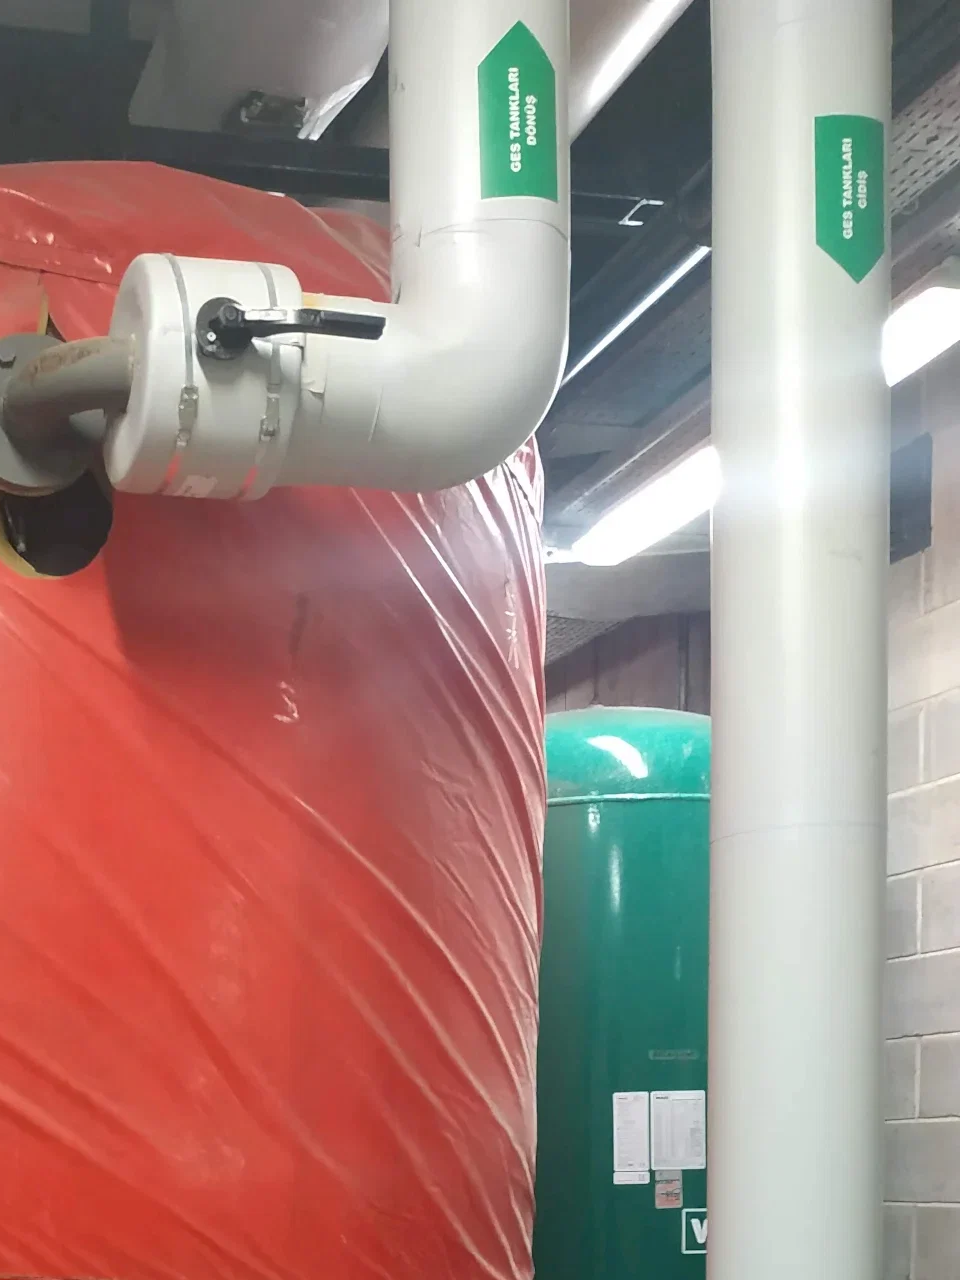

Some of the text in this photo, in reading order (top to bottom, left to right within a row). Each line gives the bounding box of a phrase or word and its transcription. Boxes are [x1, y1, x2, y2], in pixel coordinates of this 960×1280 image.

[508, 67, 522, 172] GES TANKLARI
[524, 95, 538, 146] DÖNÜŞ
[841, 138, 853, 239] GES TANKLARI
[856, 170, 869, 209] GİDİŞ
